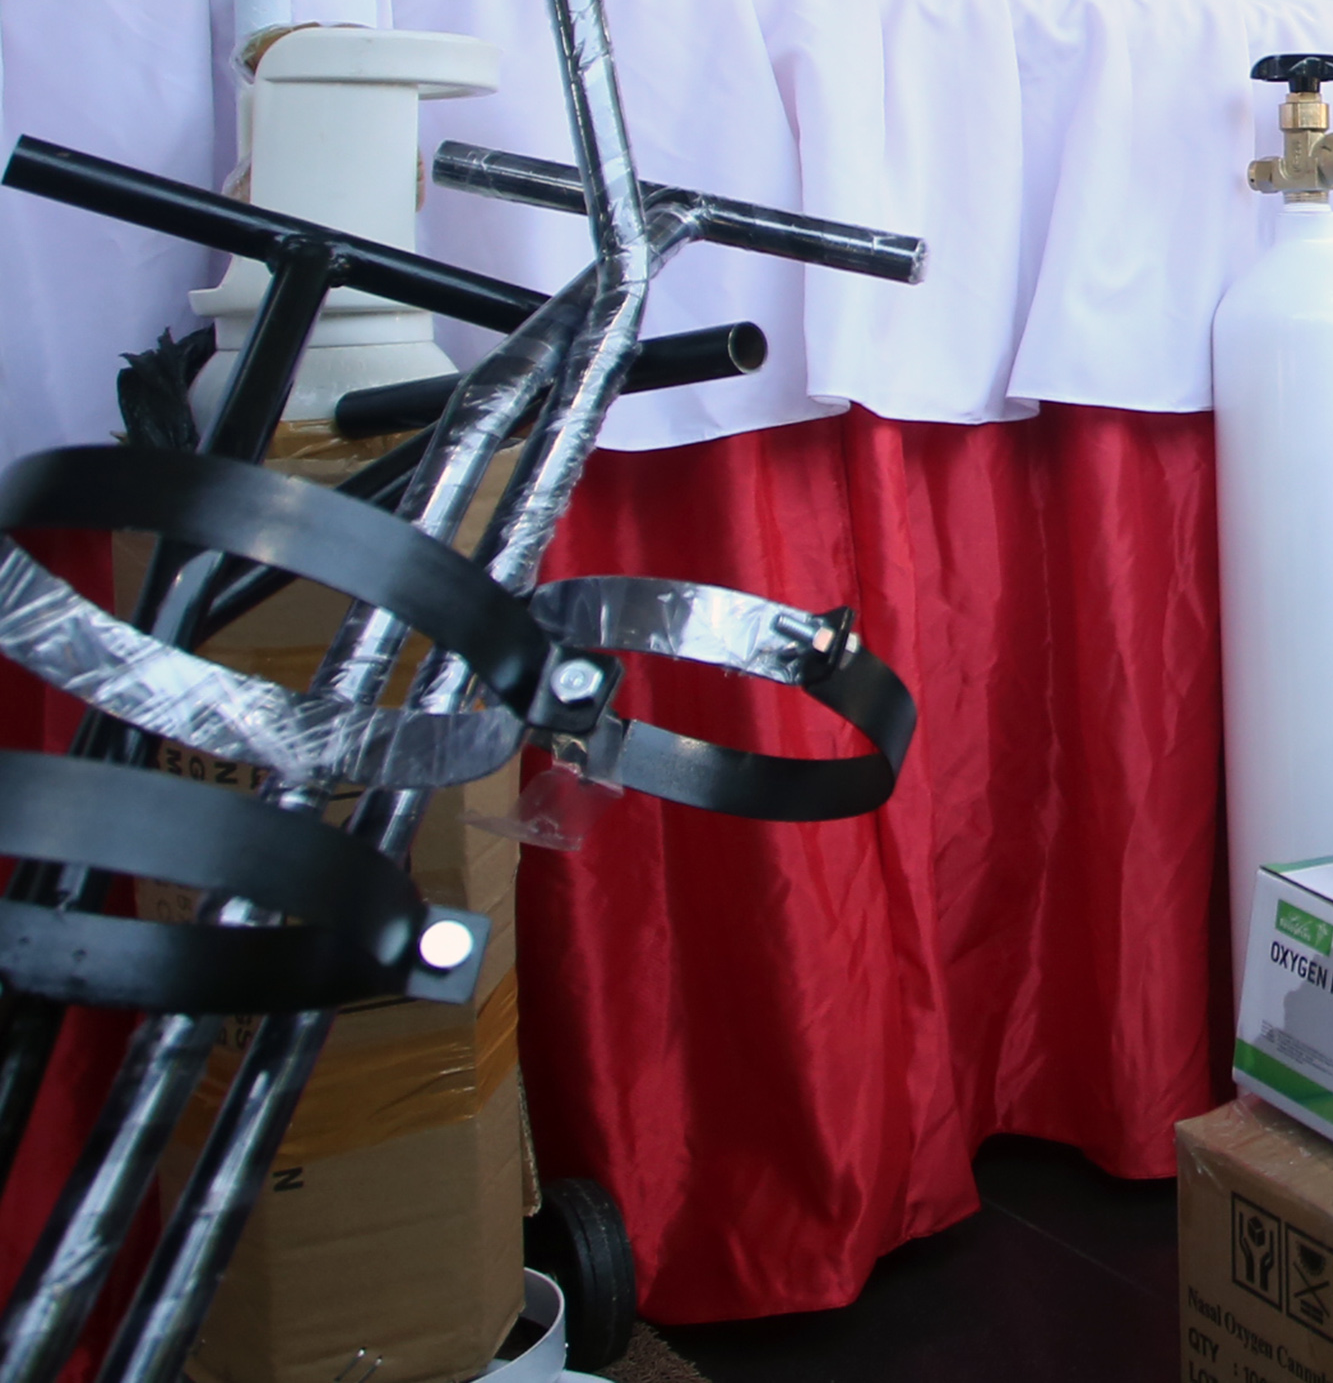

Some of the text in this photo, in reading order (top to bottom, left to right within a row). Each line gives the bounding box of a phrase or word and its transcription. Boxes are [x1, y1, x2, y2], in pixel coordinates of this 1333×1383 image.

[1270, 940, 1328, 990] OXYGEN
[1188, 1285, 1221, 1327] Nasal
[1224, 1311, 1273, 1360] Oxygen
[1188, 1326, 1219, 1364] QTY
